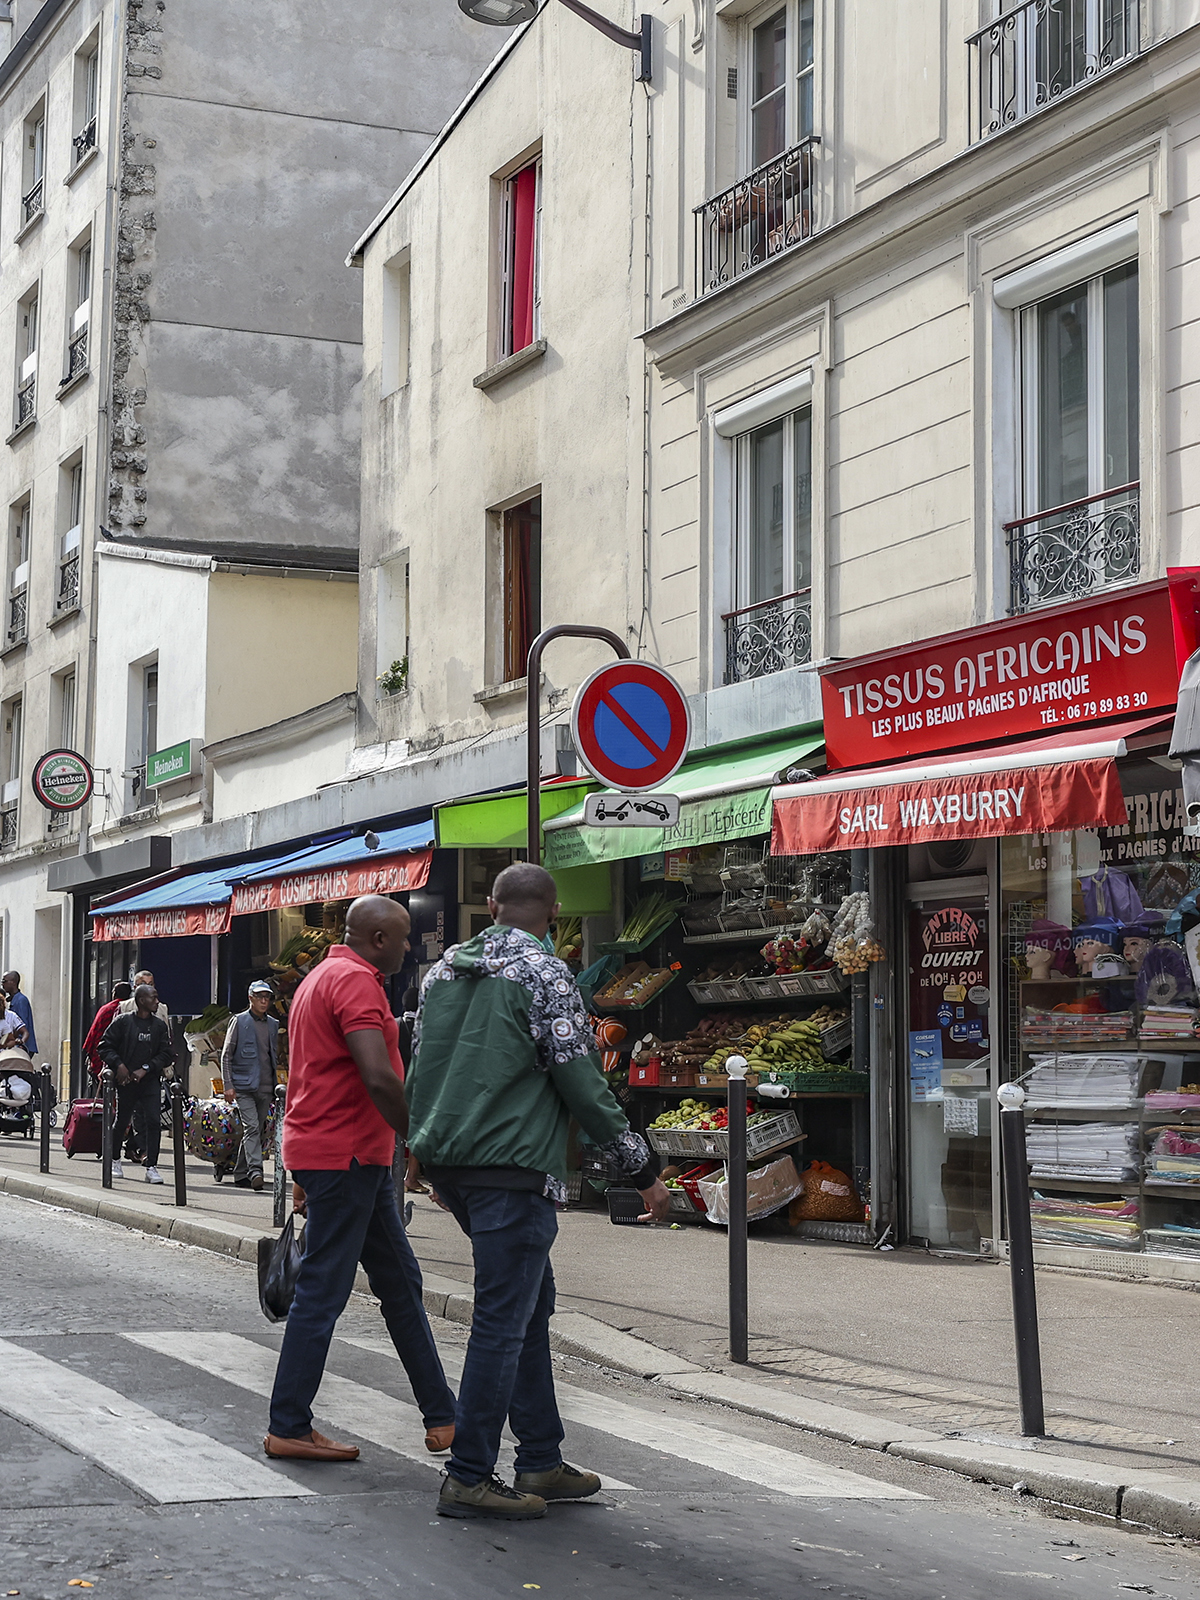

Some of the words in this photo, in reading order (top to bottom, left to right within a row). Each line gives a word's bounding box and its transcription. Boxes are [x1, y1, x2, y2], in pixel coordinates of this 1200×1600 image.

[839, 664, 945, 718] TISSUS
[954, 615, 1147, 697] AFRICAINS
[872, 719, 892, 738] LES
[895, 712, 923, 734] PLUS
[926, 702, 965, 727] BEAUX
[968, 690, 1015, 718] PAGNES
[1018, 674, 1090, 707] D'AFRIQUE
[1067, 704, 1081, 719] 06
[1083, 701, 1097, 716] 79
[1099, 698, 1114, 713] 89
[1116, 694, 1131, 710] 83
[1133, 691, 1148, 706] 30
[153, 755, 184, 777] Heineken
[44, 773, 85, 788] Heineken
[839, 803, 888, 834] SARL
[900, 786, 1025, 828] WAXBURRY
[1028, 856, 1048, 871] Les
[1118, 839, 1167, 860] PAGNES
[235, 883, 273, 913] MARKET
[280, 870, 348, 905] COSMETIQUES
[358, 873, 367, 891] 01
[368, 871, 377, 890] 42
[389, 867, 398, 887] 52
[399, 867, 409, 886] 02
[104, 914, 140, 938] PRODUITS
[144, 910, 187, 936] EXOTIQUES
[922, 907, 979, 952] ENTREE
[935, 931, 967, 944] LIBRE
[921, 950, 984, 968] OUVERT
[920, 978, 929, 986] DE
